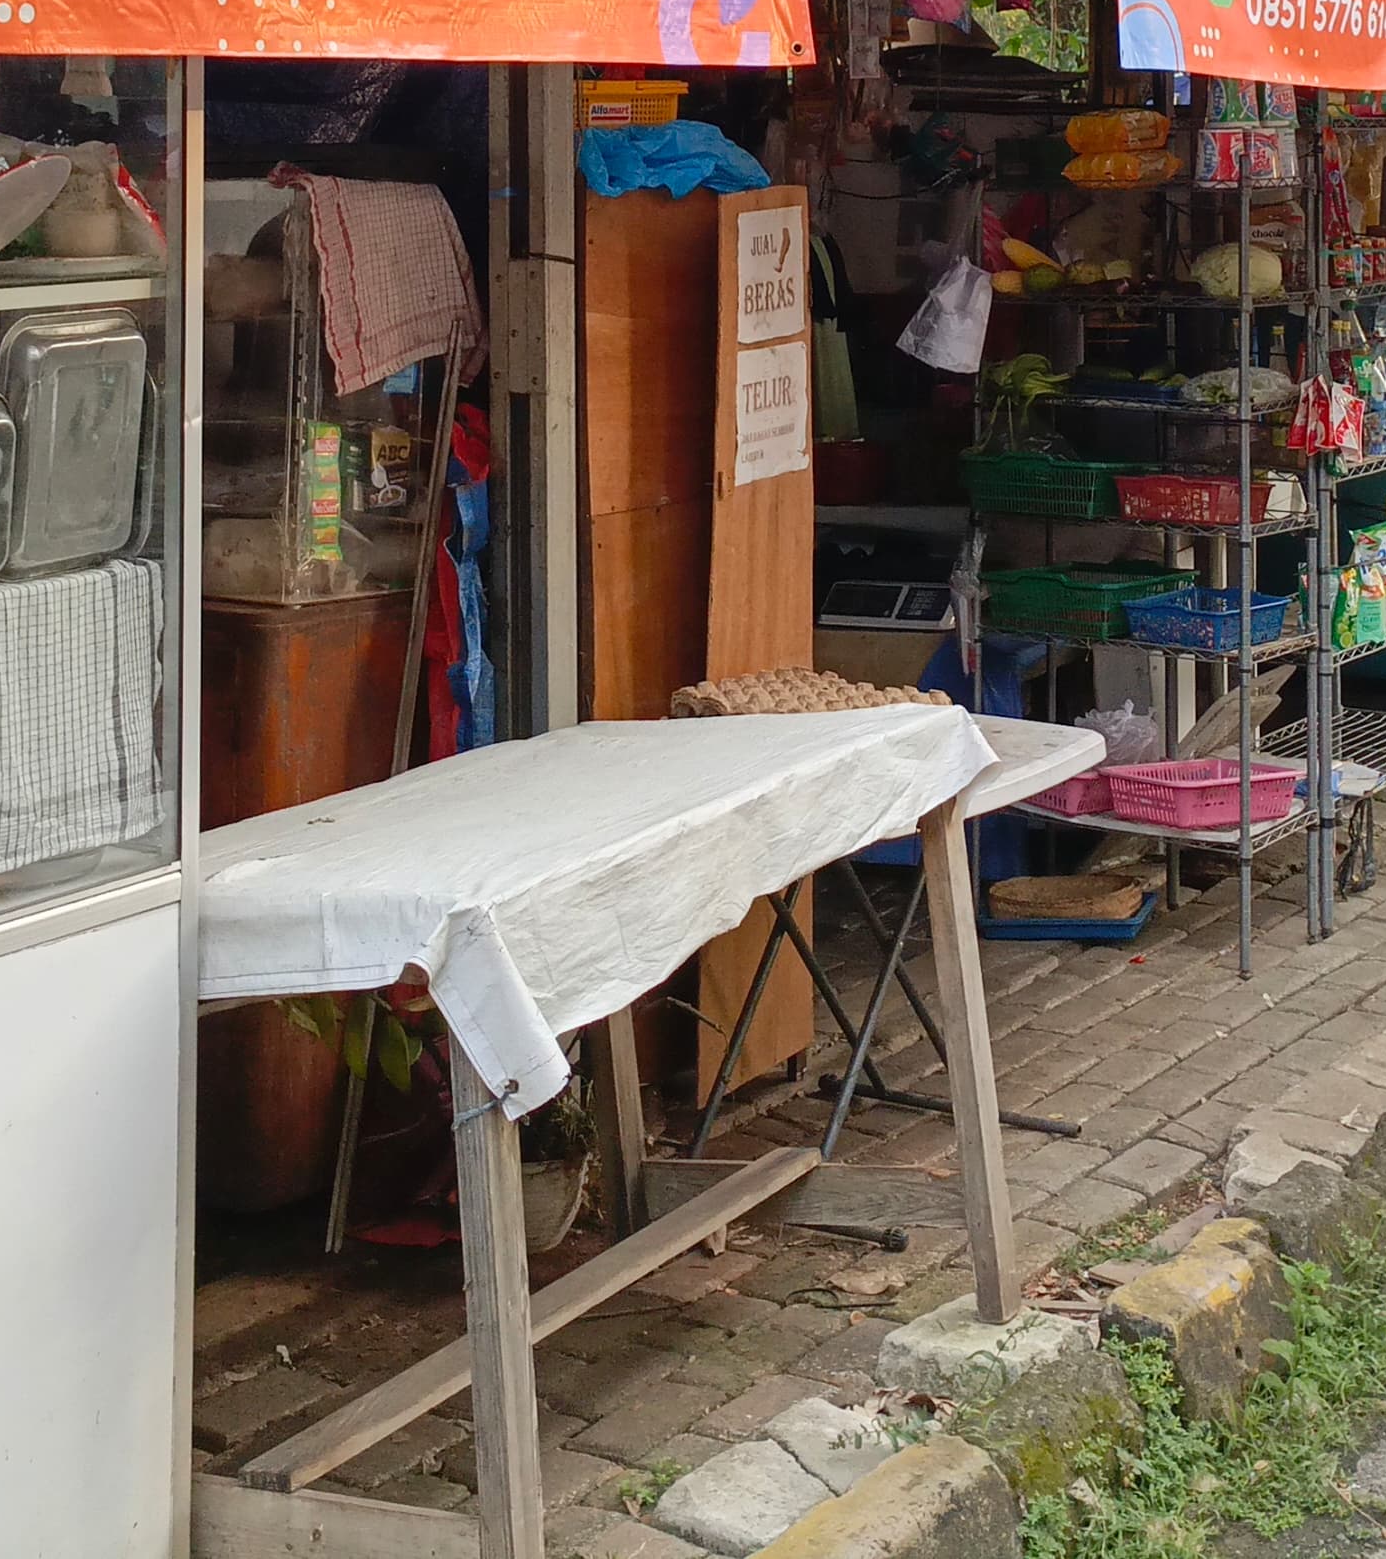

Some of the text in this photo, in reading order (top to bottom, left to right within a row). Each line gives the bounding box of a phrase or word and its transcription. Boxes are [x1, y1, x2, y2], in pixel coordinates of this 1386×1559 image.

[750, 235, 777, 257] JUAL
[744, 277, 796, 316] BERAS
[742, 375, 792, 415] TELUR
[376, 443, 409, 462] ABC
